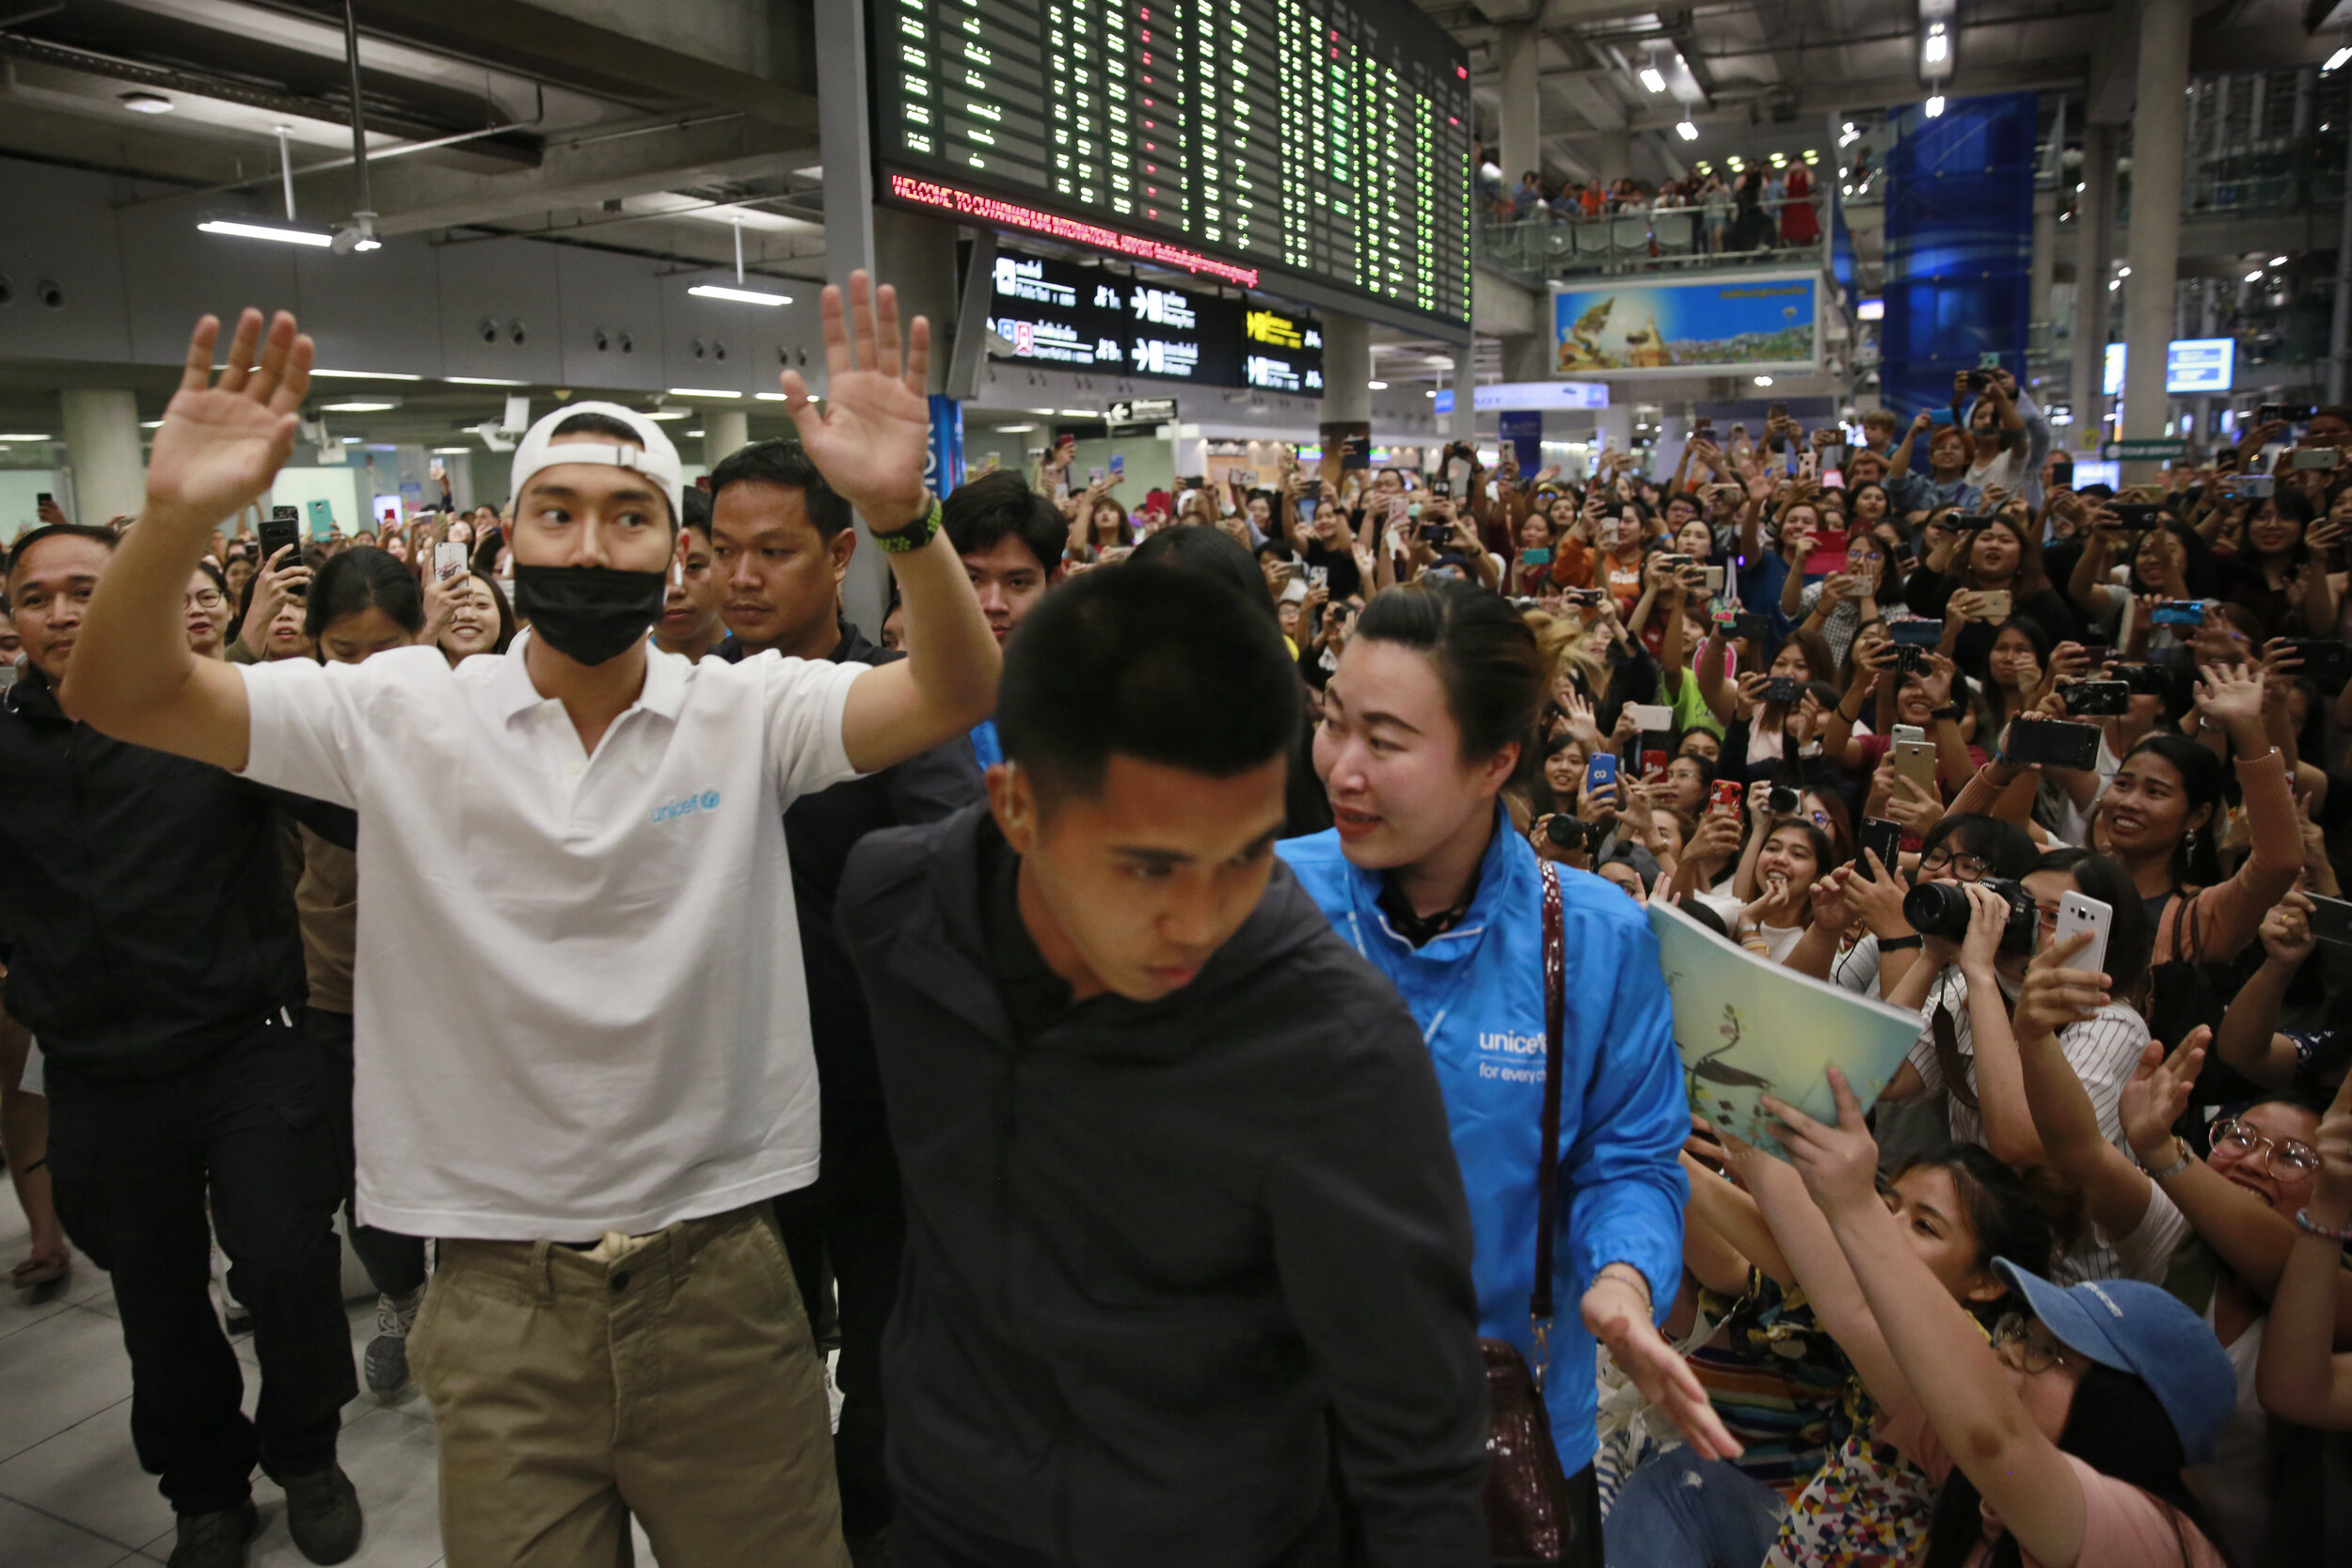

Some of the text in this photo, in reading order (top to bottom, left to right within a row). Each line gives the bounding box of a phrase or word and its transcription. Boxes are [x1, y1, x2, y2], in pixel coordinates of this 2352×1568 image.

[892, 174, 954, 209] WELCOME
[954, 190, 973, 213] TO
[651, 794, 698, 823] unicef
[1979, 879, 1996, 891] Canon
[1479, 1062, 1500, 1079] for
[1502, 1067, 1536, 1085] every
